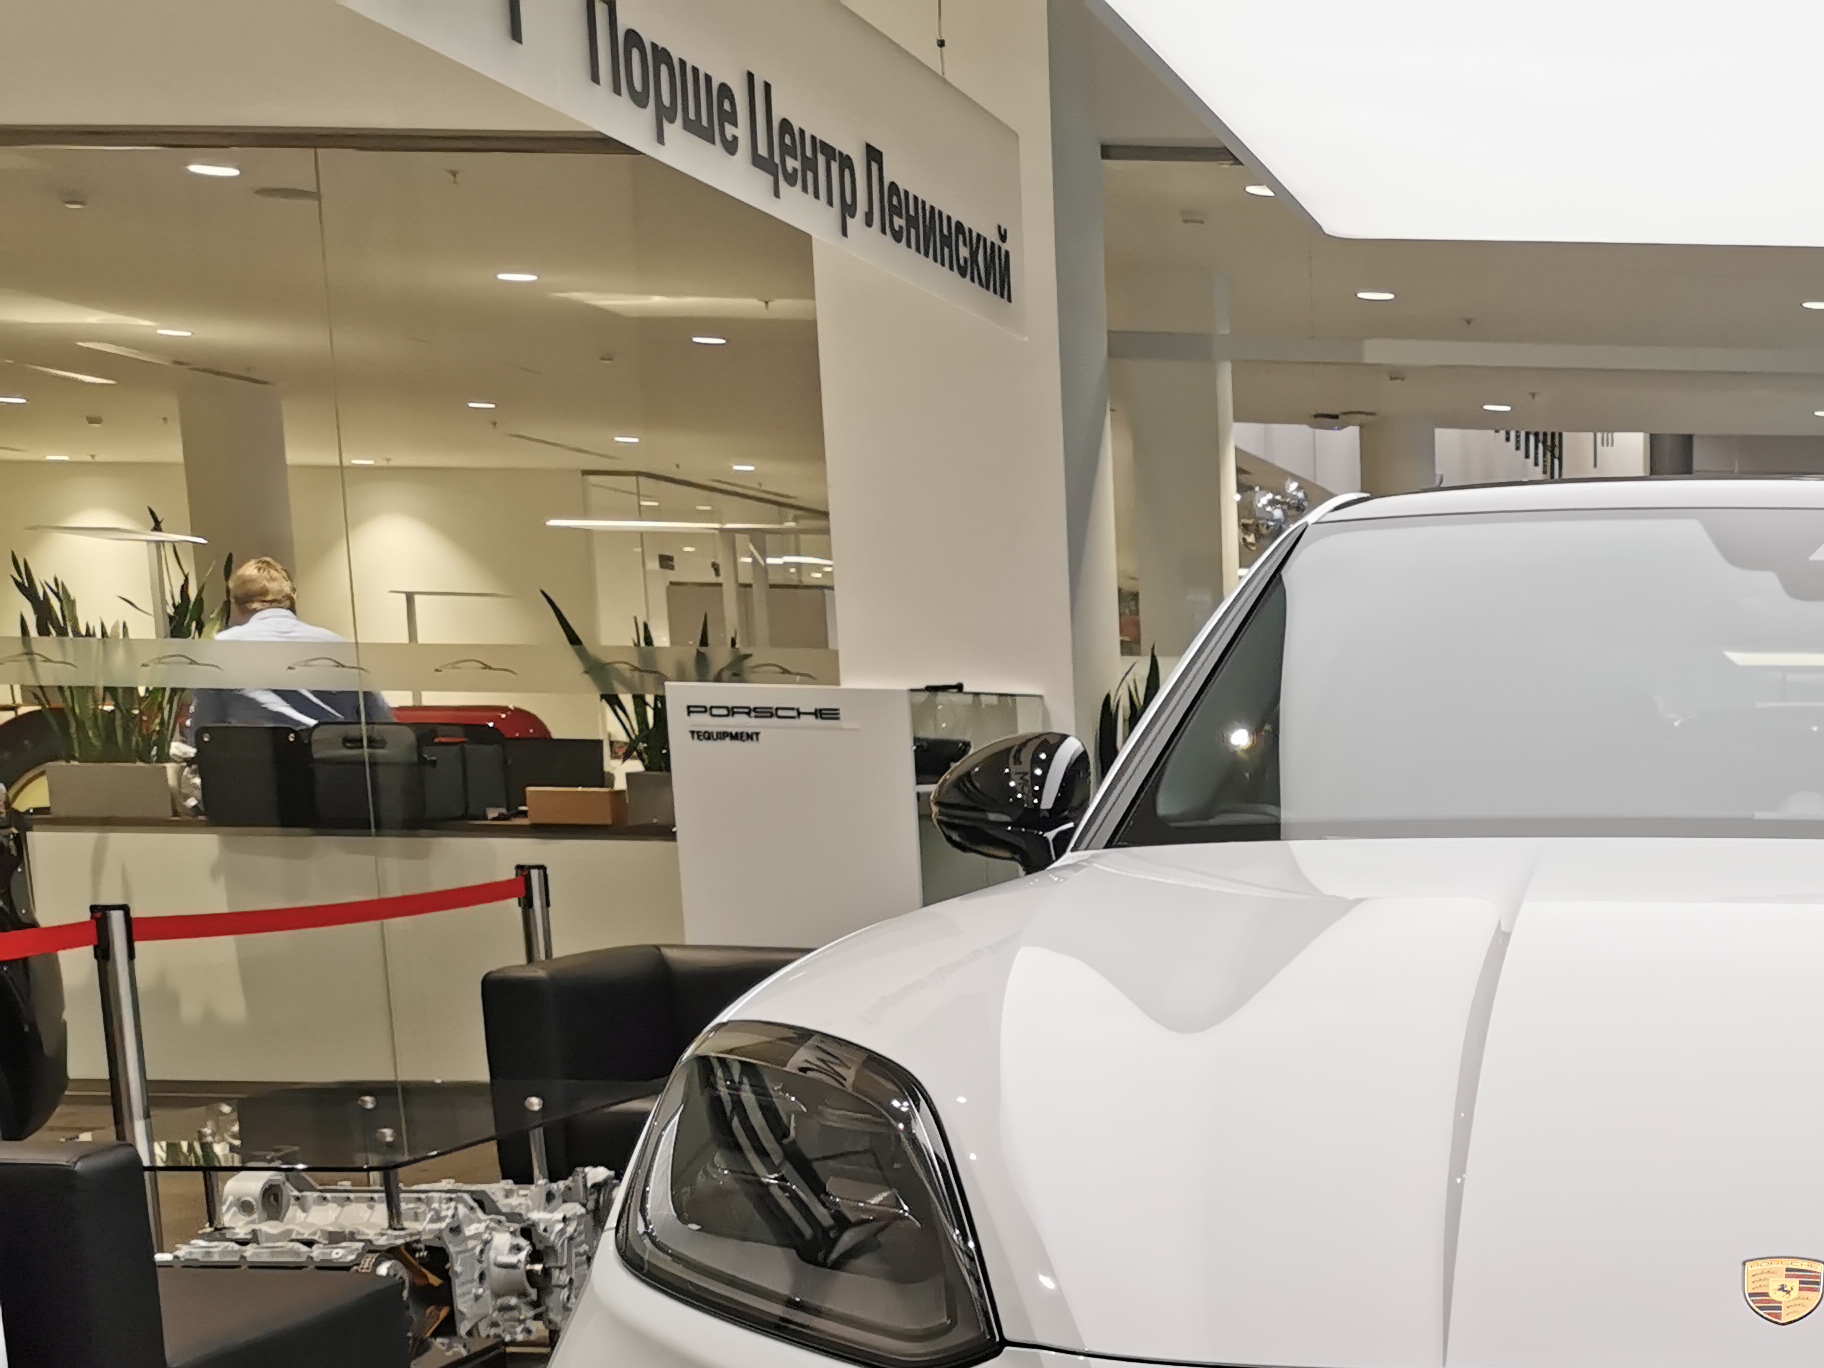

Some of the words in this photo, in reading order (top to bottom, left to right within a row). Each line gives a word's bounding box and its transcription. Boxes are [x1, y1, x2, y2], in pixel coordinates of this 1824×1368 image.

[585, 0, 739, 156] Порше
[746, 70, 858, 239] Центр
[865, 142, 1013, 304] Ленинский
[686, 704, 841, 721] PORSCHE
[689, 730, 762, 743] TEQUIPMENT
